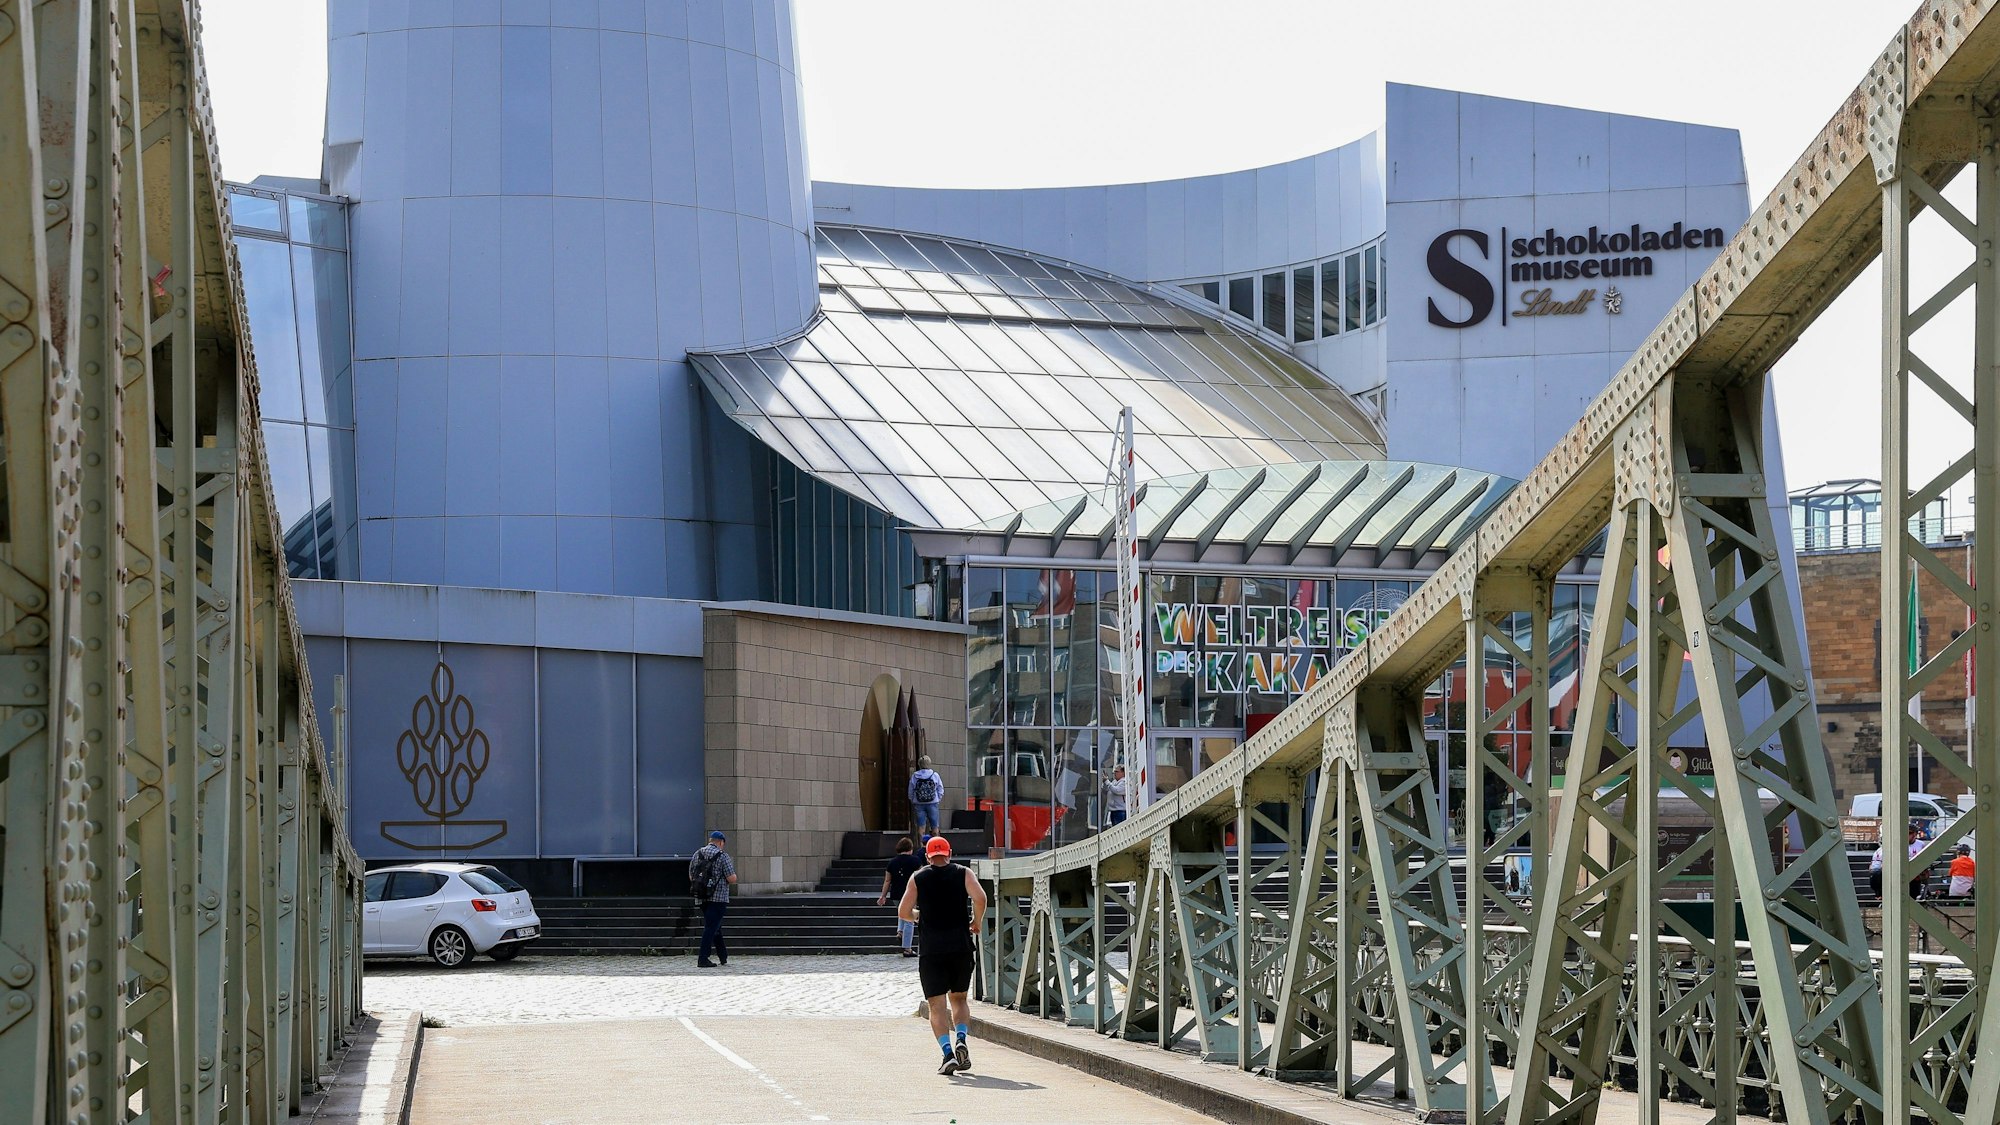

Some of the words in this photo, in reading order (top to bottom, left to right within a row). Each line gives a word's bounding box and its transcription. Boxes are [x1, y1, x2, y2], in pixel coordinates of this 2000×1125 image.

[1511, 222, 1724, 257] schokoladen
[1427, 229, 1494, 328] S
[1511, 256, 1653, 281] museum
[1512, 288, 1598, 317] Lindt
[1156, 651, 1201, 673] DES
[1205, 651, 1350, 694] KAKA
[1691, 757, 1714, 774] Glüc
